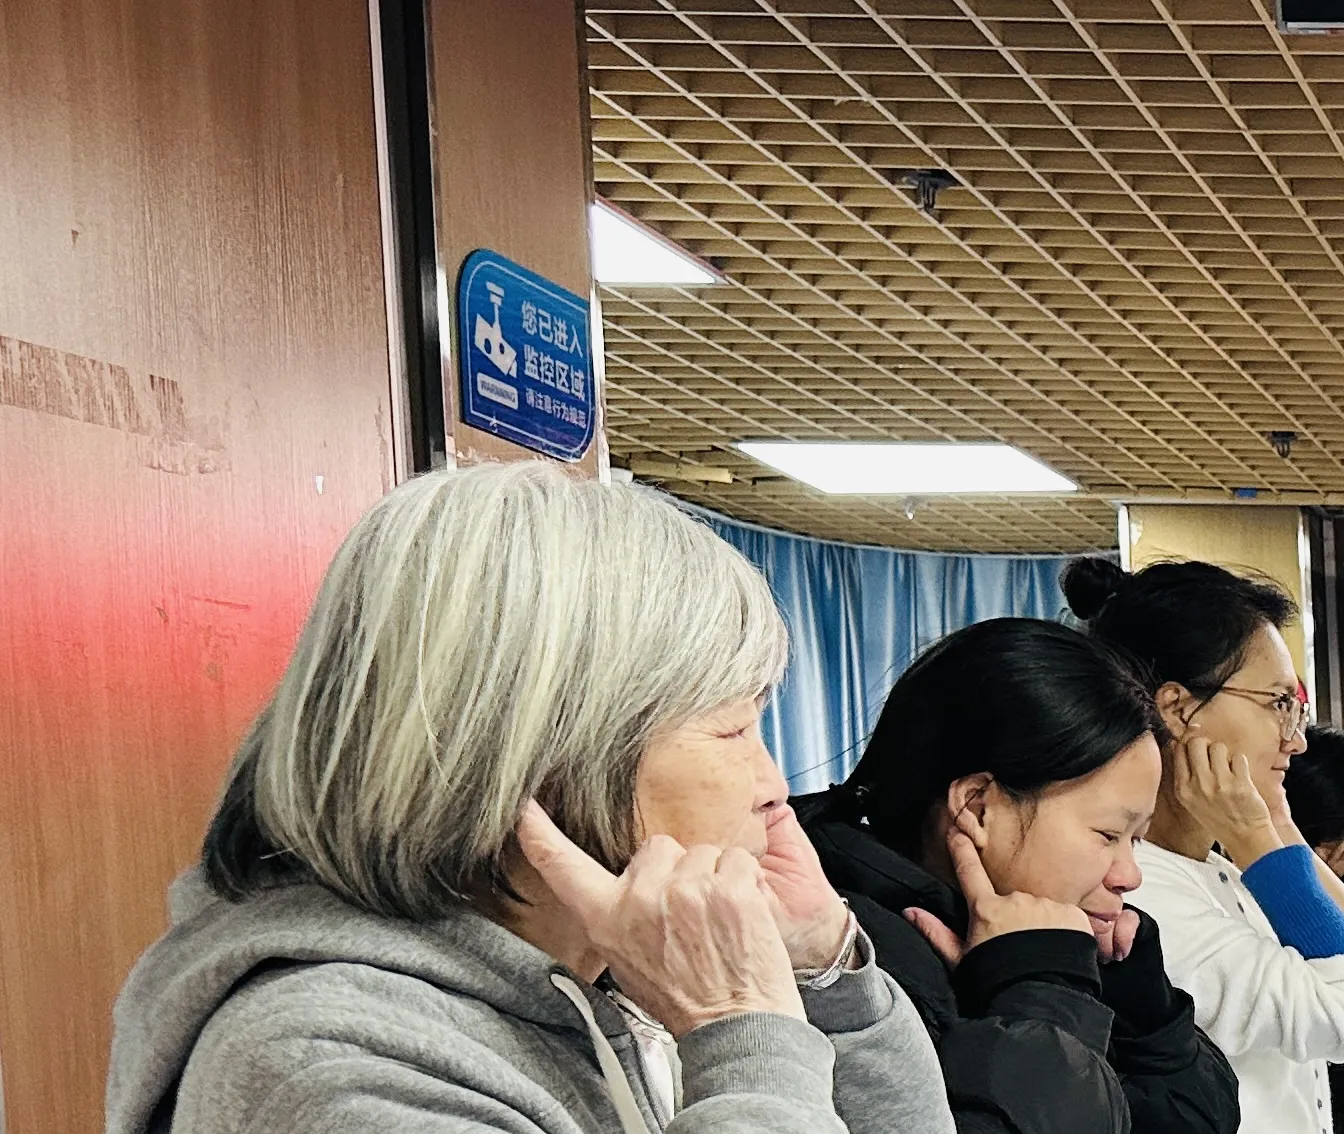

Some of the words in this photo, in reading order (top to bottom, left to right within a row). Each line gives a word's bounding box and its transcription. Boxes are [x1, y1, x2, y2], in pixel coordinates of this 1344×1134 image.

[521, 300, 584, 358] 您已进入
[523, 344, 586, 402] 监控区域
